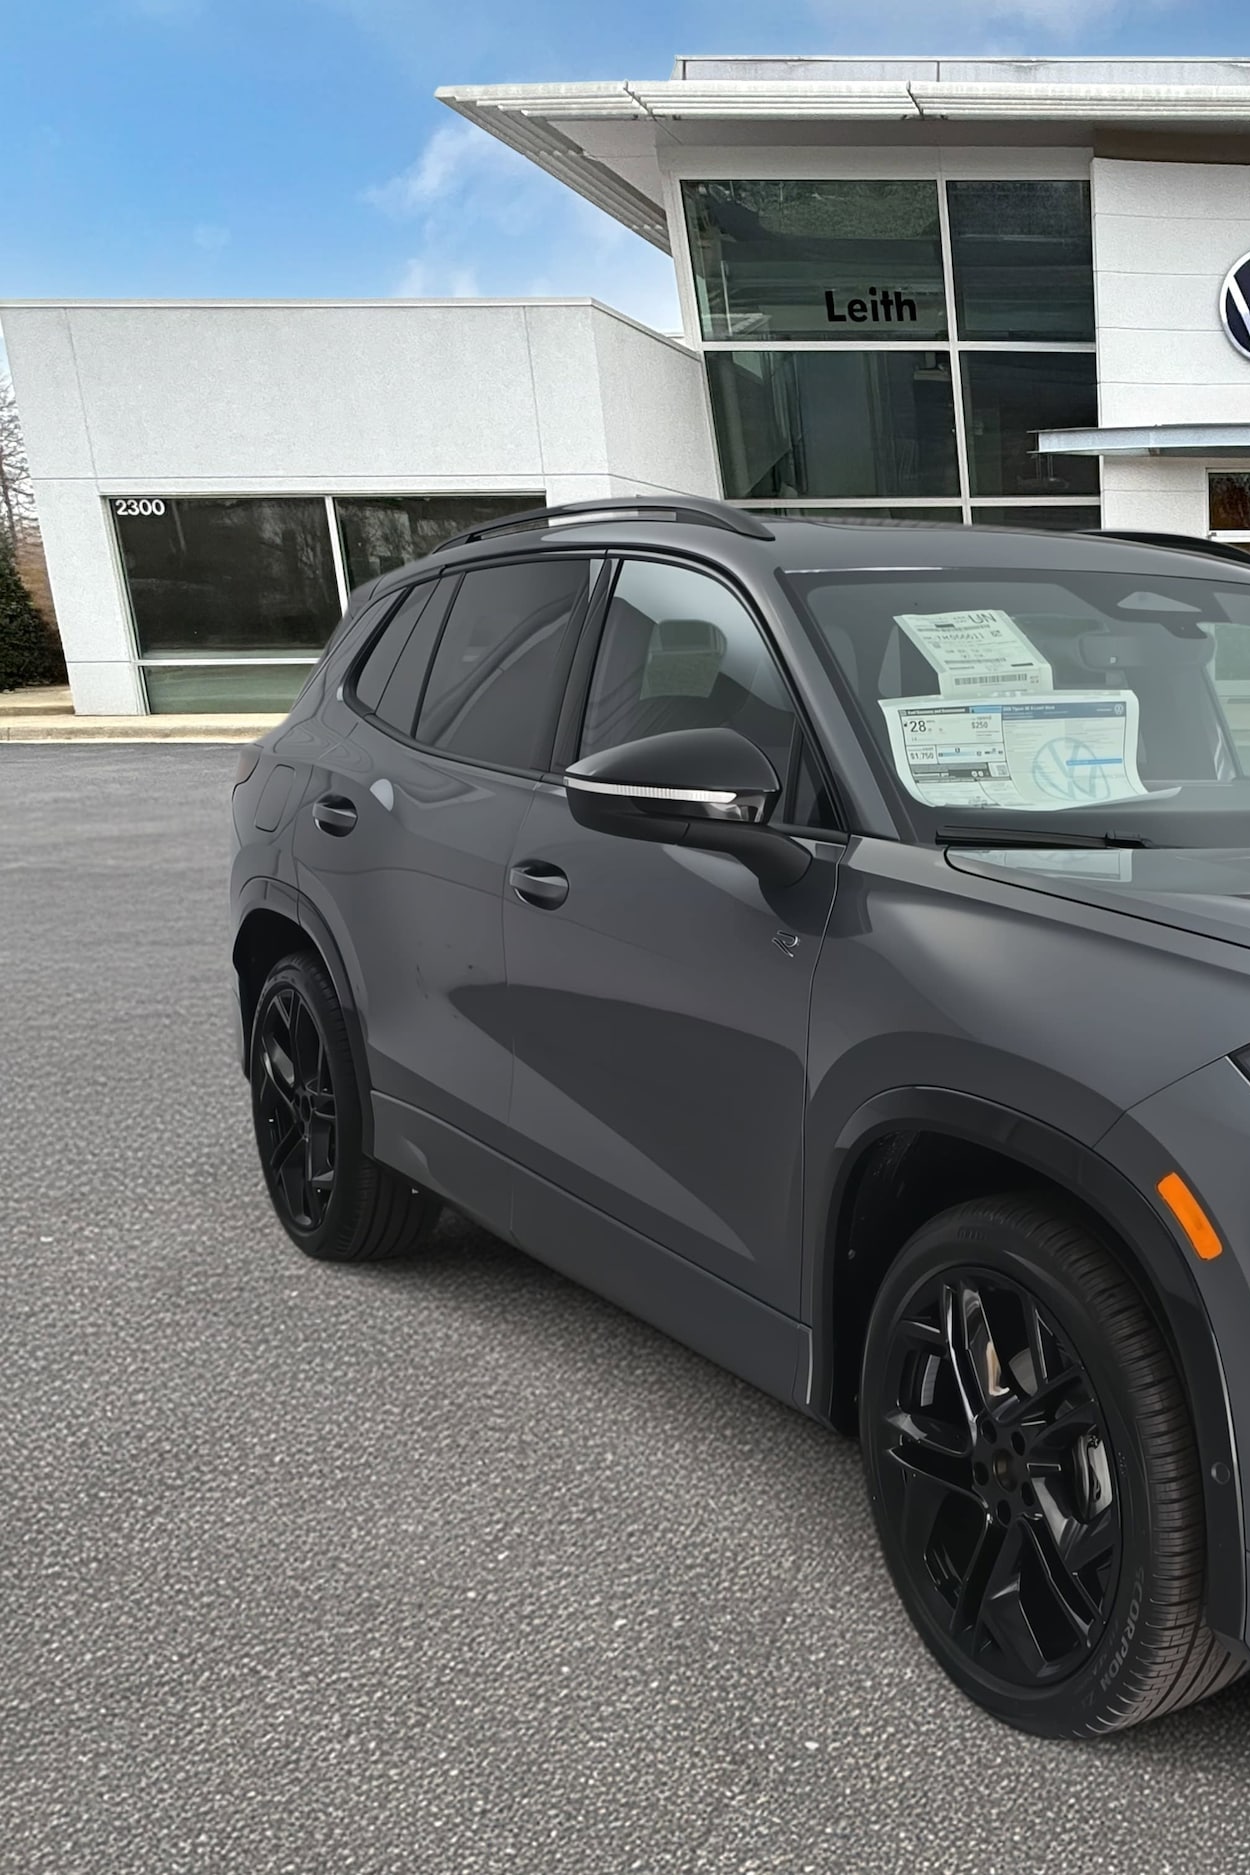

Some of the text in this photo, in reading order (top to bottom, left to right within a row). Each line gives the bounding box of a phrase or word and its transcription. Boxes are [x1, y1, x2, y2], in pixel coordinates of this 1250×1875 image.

[825, 286, 917, 322] Leith
[115, 499, 166, 516] 2300
[968, 613, 997, 624] UN
[909, 720, 927, 732] 28
[1100, 1567, 1145, 1691] SCORPION
